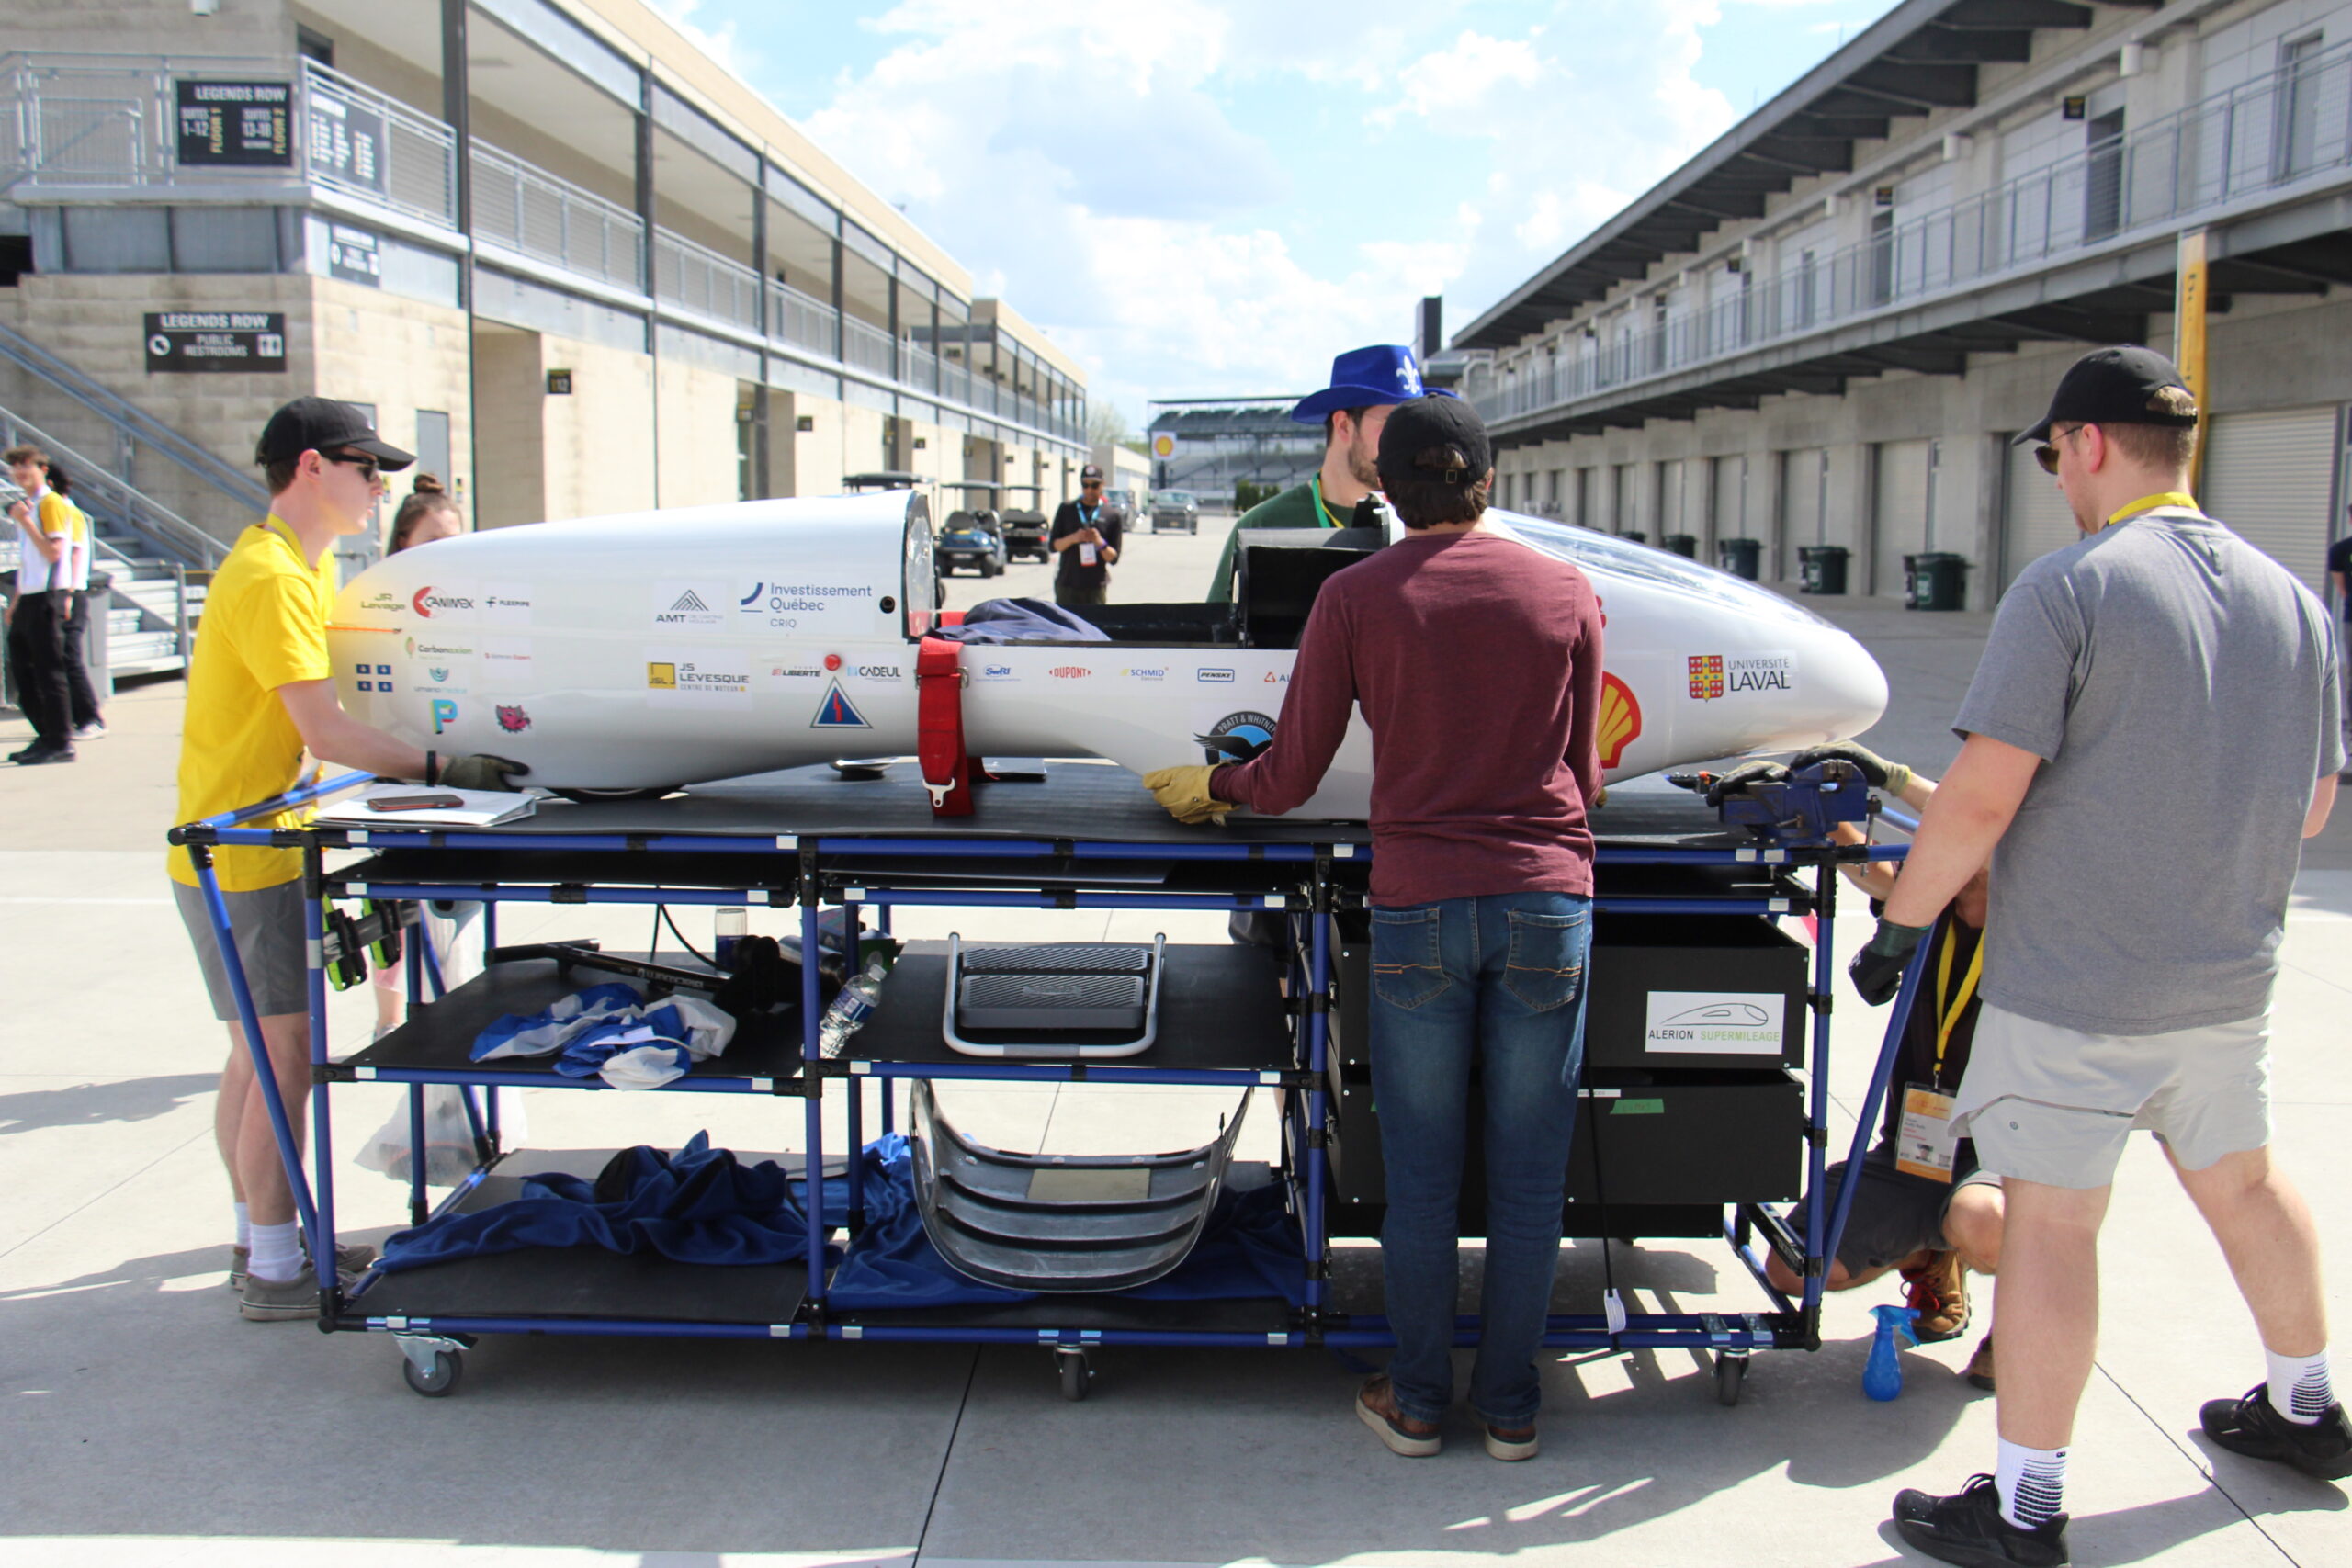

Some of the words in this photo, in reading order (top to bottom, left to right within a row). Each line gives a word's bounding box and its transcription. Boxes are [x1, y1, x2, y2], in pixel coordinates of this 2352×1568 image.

[195, 86, 253, 101] LEGENDS
[254, 86, 287, 102] ROW
[182, 120, 209, 137] 1-12
[210, 117, 223, 153] FLOOR
[273, 118, 286, 154] FLOOR
[161, 314, 229, 328] LEGENDS
[231, 314, 269, 328] ROW
[196, 334, 234, 345] PUBLIC
[184, 345, 248, 357] RESTROOMS
[770, 582, 872, 598] Investissement
[361, 602, 405, 612] Lavage
[424, 596, 474, 609] CANIMEX
[770, 598, 825, 613] Québec
[655, 614, 686, 623] AMT
[770, 619, 797, 628] CRIQ
[679, 663, 695, 671] JS
[1728, 655, 1790, 670] UNIVERSITÉ
[859, 666, 901, 677] CADEUL
[1054, 667, 1085, 678] DUPONT
[1130, 669, 1164, 677] SCHMID
[679, 673, 750, 683] LEVESQUE
[1279, 674, 1291, 682] AL
[1730, 671, 1791, 692] LAVAL
[1217, 716, 1239, 733] PRATT
[1240, 714, 1247, 723] &
[1648, 1030, 1694, 1040] ALERION
[1700, 1030, 1781, 1042] SUPERMILEAGE
